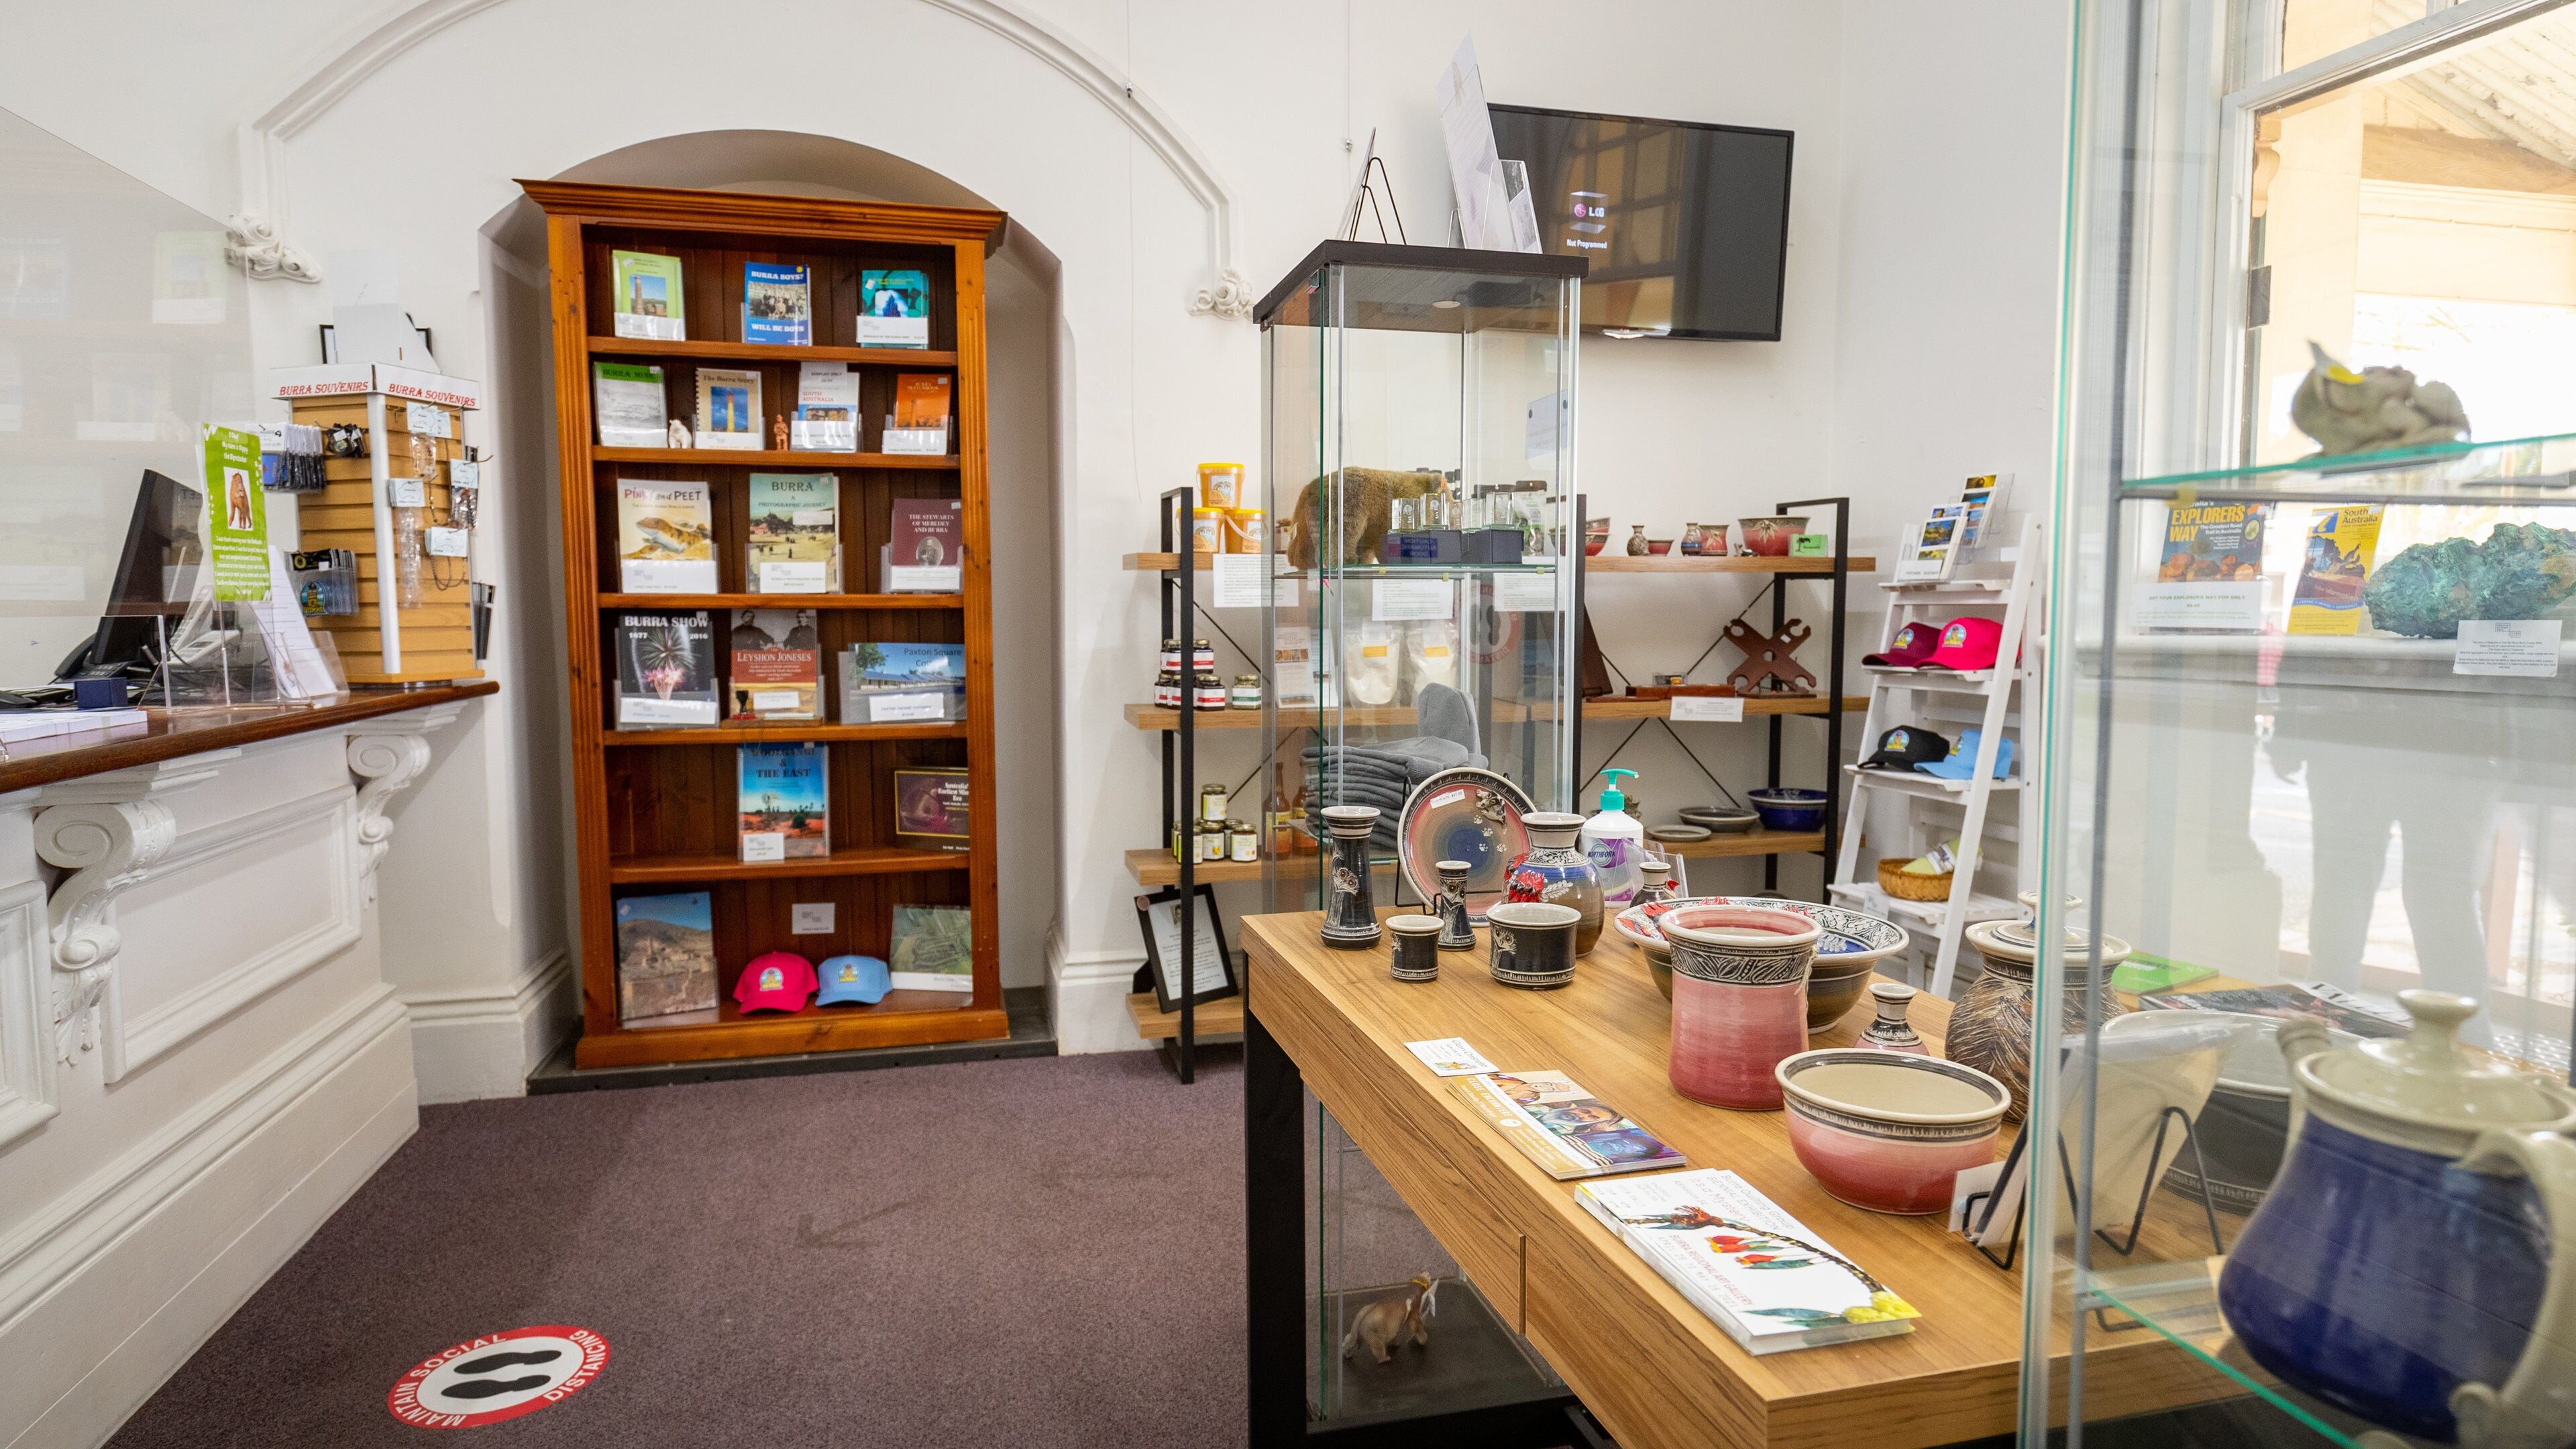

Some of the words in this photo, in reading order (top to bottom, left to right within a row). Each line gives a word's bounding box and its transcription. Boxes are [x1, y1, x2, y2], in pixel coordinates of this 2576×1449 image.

[1589, 207, 1605, 217] LG
[1566, 239, 1576, 247] Not
[1577, 239, 1607, 249] Programmed
[751, 271, 778, 280] BURRA
[751, 323, 771, 331] WILL
[279, 384, 312, 396] BURRA
[315, 381, 369, 394] SOUVENIRS
[389, 384, 421, 396] BURRA
[425, 390, 476, 407] SOUVENIRS
[771, 482, 814, 491] BURRA
[655, 492, 672, 500] and
[674, 490, 702, 500] PEET
[2171, 504, 2246, 525] EXPLORERS
[2344, 508, 2369, 517] South
[2342, 515, 2378, 524] Australia
[2169, 525, 2200, 543] WAY
[625, 616, 668, 627] BURRA
[672, 616, 708, 627] SHOW
[737, 652, 775, 661] LEYSHON
[777, 652, 811, 661] JONESES
[934, 649, 962, 658] Square
[757, 769, 779, 777] THE
[783, 769, 810, 777] EAST
[1466, 1077, 1483, 1091] CLOSE
[1481, 1092, 1513, 1116] ENCOUNTERS
[1707, 1177, 1739, 1199] BIENNIAL
[1737, 1198, 1781, 1230] EXHIBITION
[1709, 1193, 1750, 1222] Mystery
[1721, 1175, 1743, 1189] Burra
[1741, 1189, 1768, 1210] Quilting
[1770, 1208, 1794, 1229] Group
[1670, 1235, 1690, 1253] BURRA
[1690, 1250, 1715, 1274] REGIONAL
[1715, 1272, 1729, 1284] ART
[1724, 1283, 1754, 1305] GALLERY
[409, 1334, 506, 1379] SOCIAL
[394, 1382, 468, 1427] MAINTAIN
[543, 1330, 606, 1402] DISTANCING
